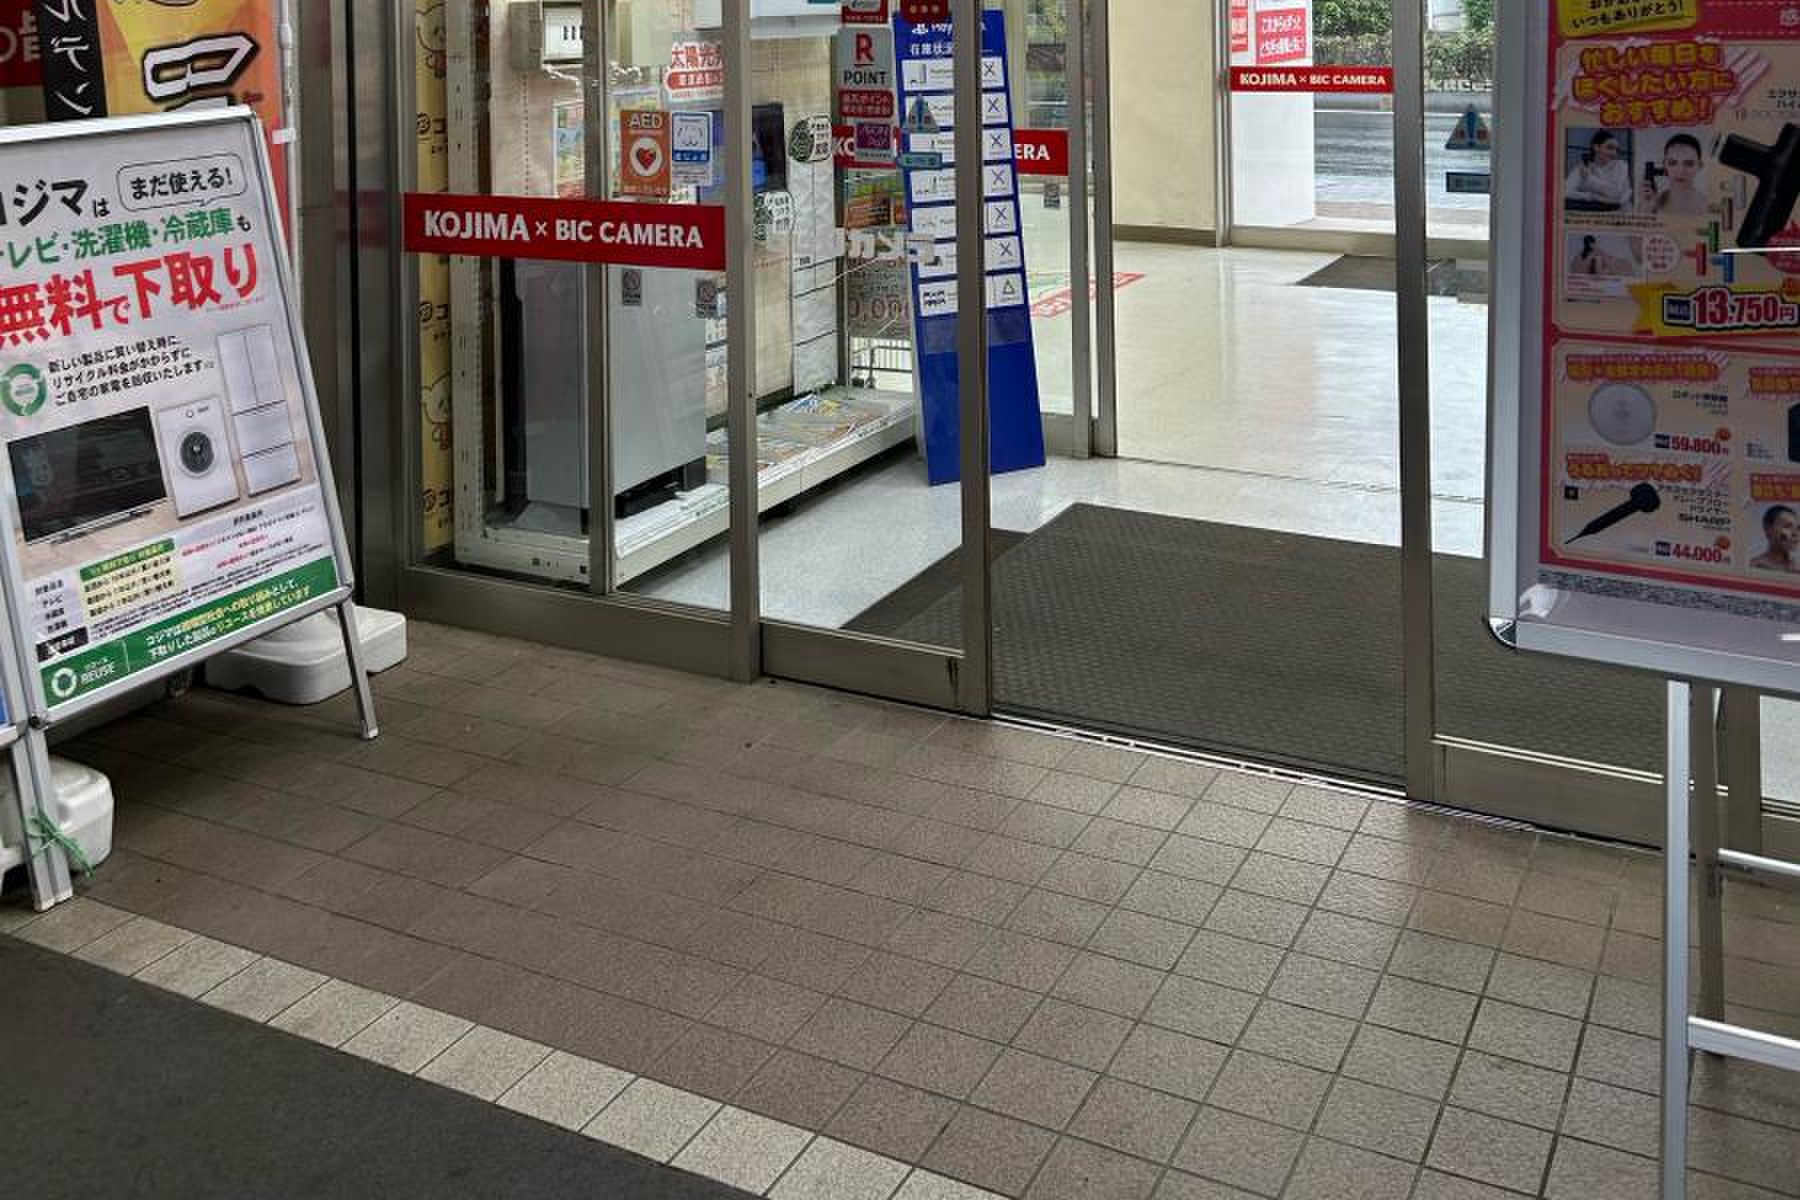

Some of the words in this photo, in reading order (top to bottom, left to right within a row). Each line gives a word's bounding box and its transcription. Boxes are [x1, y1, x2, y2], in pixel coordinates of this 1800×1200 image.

[843, 70, 888, 86] POINT
[1240, 72, 1297, 85] KOJIMA
[1333, 74, 1386, 86] CAMERA
[629, 113, 663, 129] AED
[130, 167, 234, 201] まだ使える!
[0, 179, 111, 227] ジマは
[0, 207, 251, 270] レビ・洗濯機・冷蔵庫も
[424, 209, 531, 243] KOJIMA
[555, 218, 593, 242] BIC
[600, 221, 704, 249] CAMERA
[0, 243, 258, 350] 無料で下取り
